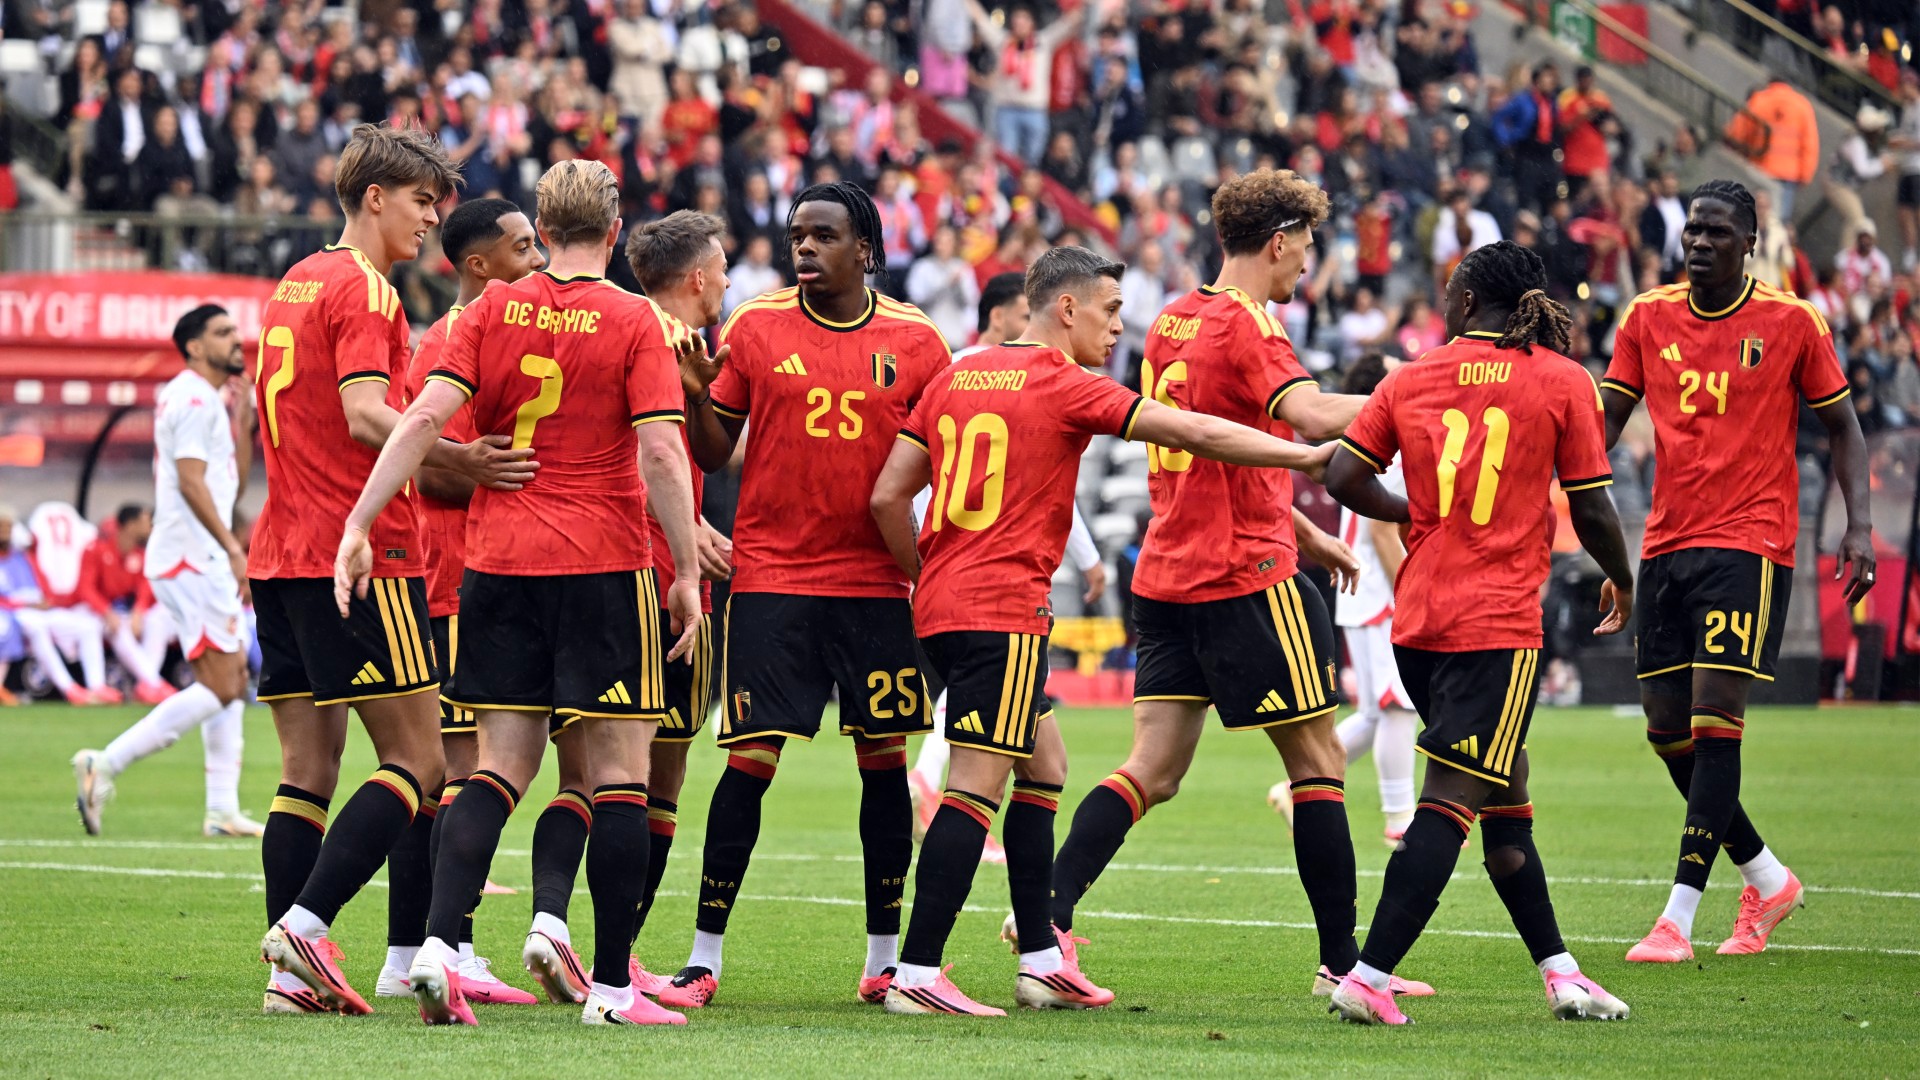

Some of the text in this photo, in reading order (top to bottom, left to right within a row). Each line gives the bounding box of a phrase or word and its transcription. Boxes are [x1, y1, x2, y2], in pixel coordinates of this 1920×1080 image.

[45, 291, 96, 338] OF
[503, 300, 601, 335] DE BRYNE
[948, 369, 1027, 391] TROSSARD
[1458, 361, 1512, 386] DOKU
[1679, 370, 1729, 415] 24
[513, 354, 564, 462] 7
[805, 387, 866, 440] 25
[931, 412, 1009, 532] 10
[1437, 406, 1510, 526] 11
[1705, 610, 1752, 656] 24
[867, 667, 917, 719] 25
